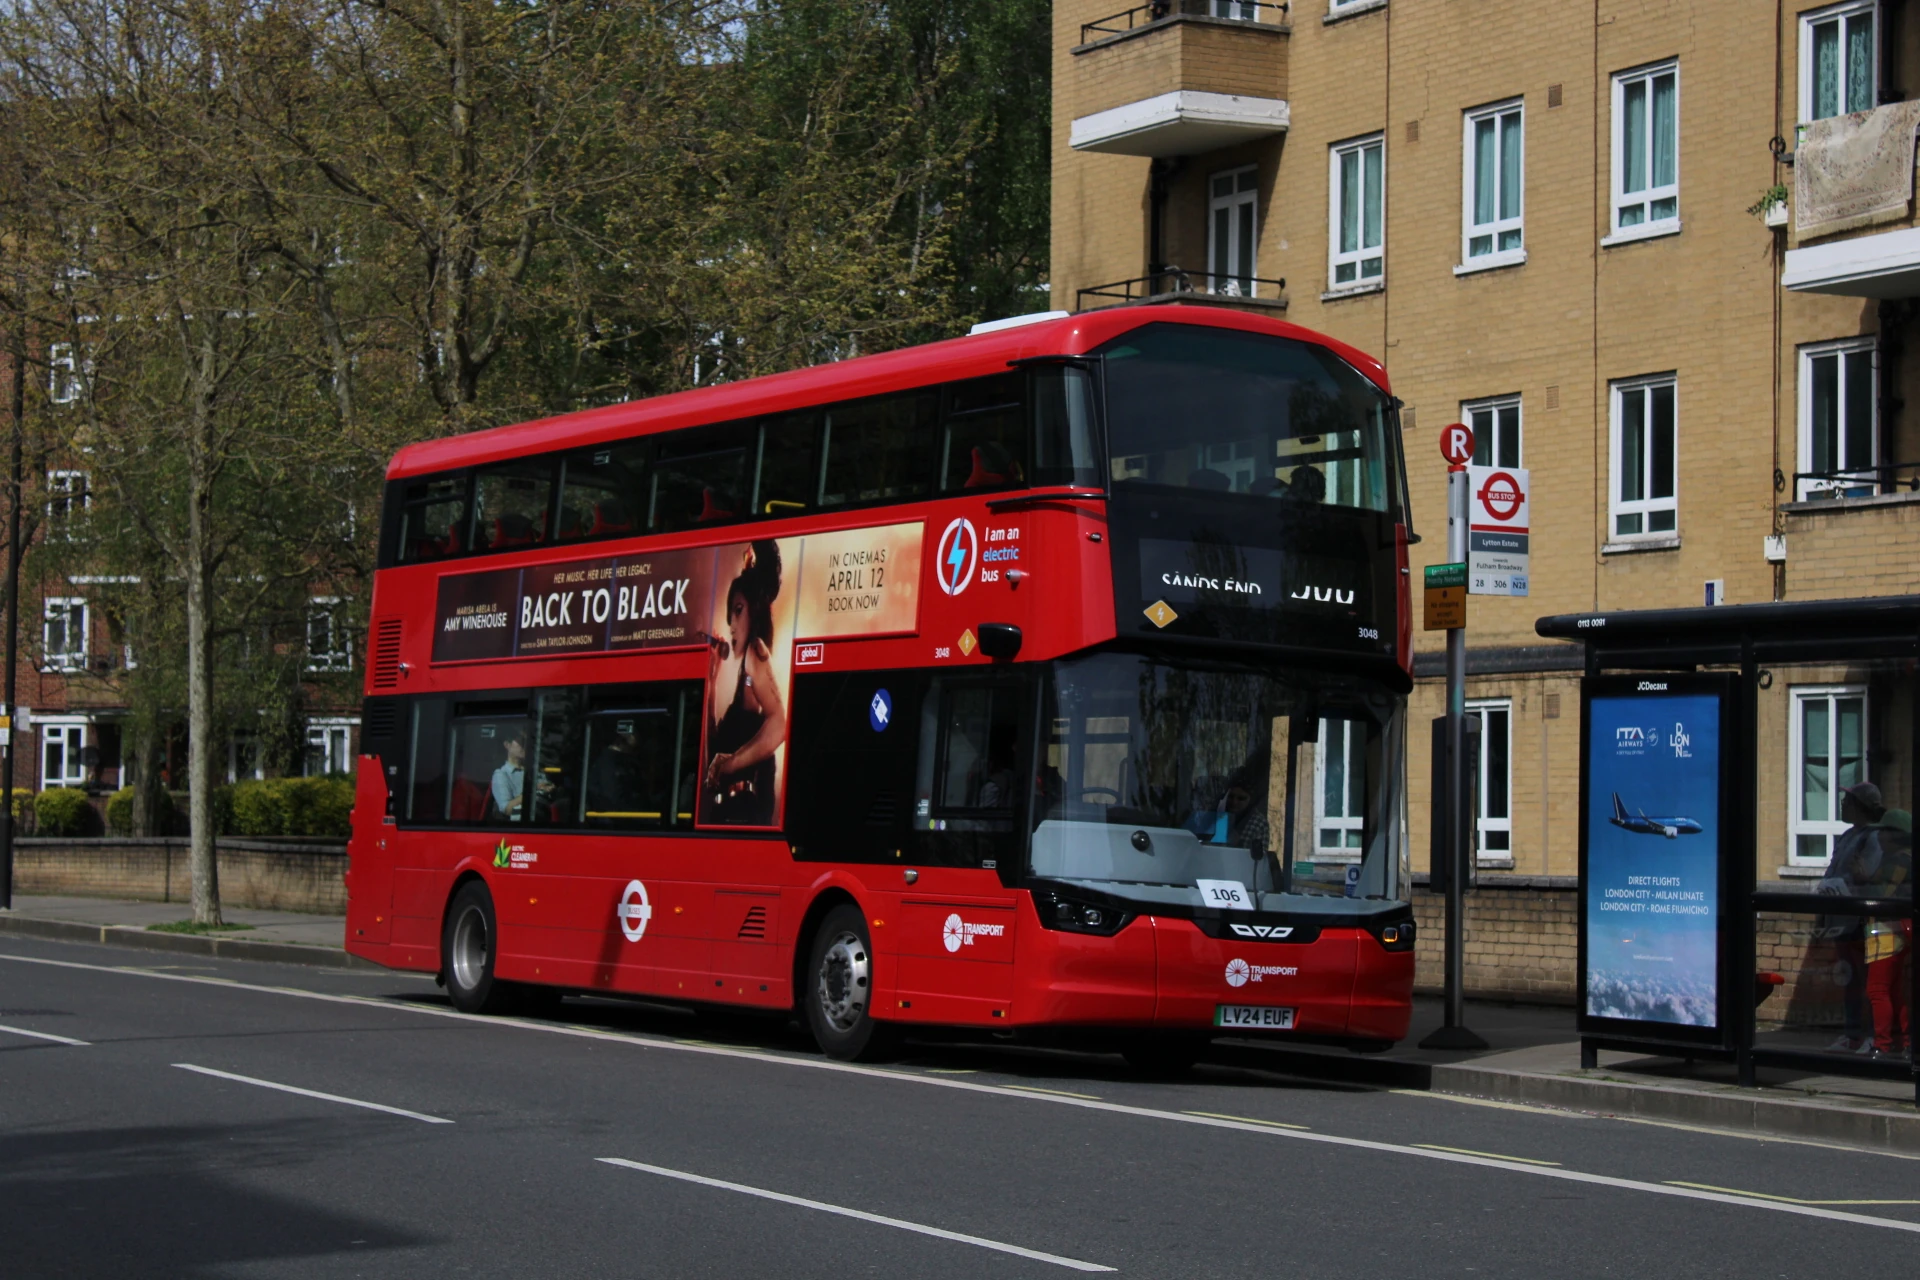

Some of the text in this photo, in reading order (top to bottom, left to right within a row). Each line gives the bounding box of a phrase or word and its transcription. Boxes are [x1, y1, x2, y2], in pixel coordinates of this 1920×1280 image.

[1451, 429, 1469, 458] R
[1488, 492, 1516, 500] BUS STOP
[984, 528, 1019, 542] I am an
[1482, 539, 1500, 547] Lytton
[829, 549, 886, 568] IN CINEMAS
[983, 546, 1019, 562] electric
[554, 573, 565, 584] HER
[566, 571, 585, 583] MUSIC.
[588, 570, 599, 581] HER
[616, 567, 627, 578] HER
[628, 564, 652, 577] LEGACY.
[1498, 564, 1523, 572] Broadway
[827, 567, 884, 592] APRIL 12
[981, 568, 999, 582] bus
[1476, 579, 1484, 587] 28
[1494, 580, 1507, 588] 306
[1512, 582, 1526, 590] N28
[456, 603, 497, 616] MARISA ABELA IS
[521, 578, 690, 629] BACK TO BLACK
[828, 595, 879, 612] BOOK NOW
[444, 612, 508, 632] AMY WINEHOUSE
[1578, 618, 1605, 628] 0113 0091
[633, 630, 646, 641] MATT
[647, 628, 684, 640] GREENHALGH
[1358, 627, 1378, 640] 3048
[537, 638, 547, 648] SAM
[935, 648, 950, 658] 3048
[1637, 682, 1668, 691] JCDecaux
[1616, 727, 1644, 739] ITA
[1628, 876, 1680, 886] DIRECT FLIGHTS
[1211, 888, 1241, 902] 106
[1605, 889, 1634, 898] LONDON
[1636, 890, 1651, 899] CITY
[1655, 892, 1678, 900] MILAN
[1679, 892, 1704, 901] LINATE
[1600, 902, 1629, 912] LONDON
[1630, 903, 1646, 912] CITY
[1650, 905, 1671, 913] ROME
[1672, 905, 1709, 915] FIUMICINO
[964, 922, 1004, 936] TRANSPORT
[963, 934, 974, 945] UK
[1250, 965, 1298, 975] TRANSPORT
[1250, 974, 1262, 982] UK
[1223, 1008, 1290, 1025] LV24 EUF
